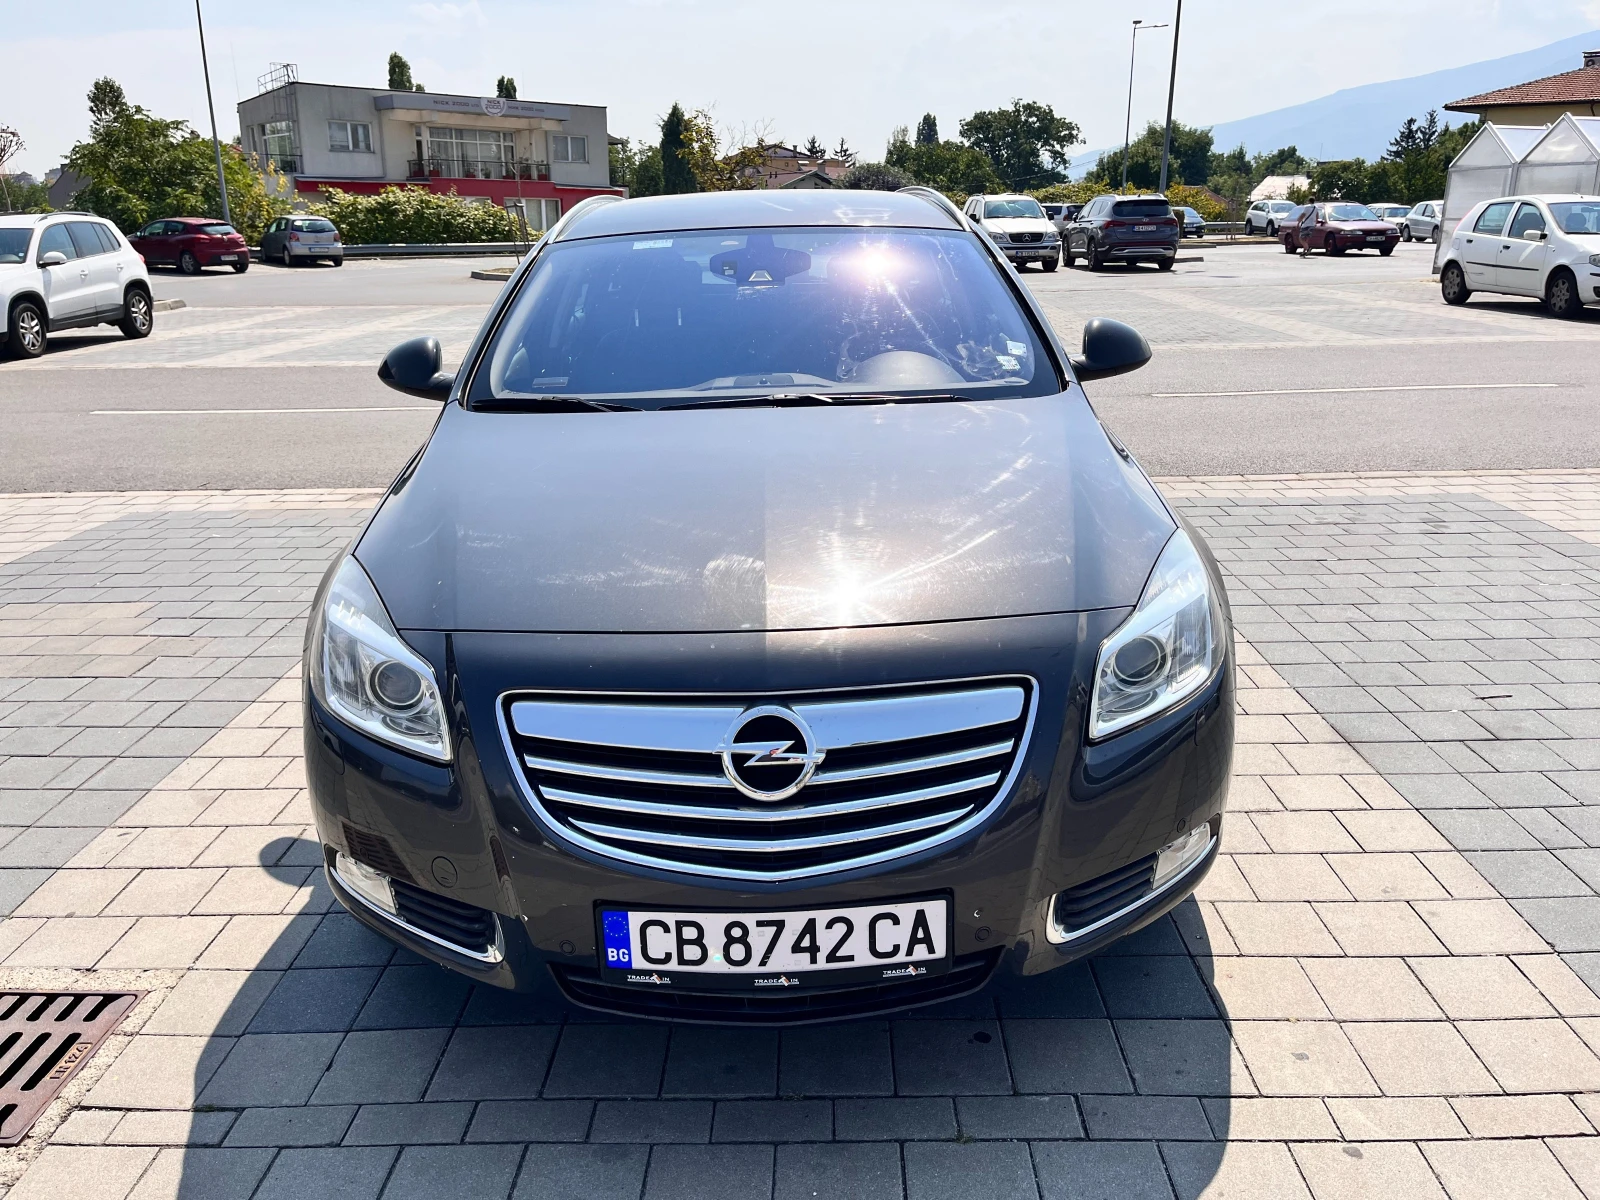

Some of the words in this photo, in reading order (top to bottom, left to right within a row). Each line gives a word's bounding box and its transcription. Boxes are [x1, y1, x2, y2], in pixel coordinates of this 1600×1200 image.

[607, 947, 630, 963] BG
[639, 919, 709, 967] CB
[722, 916, 855, 967] 8742
[868, 908, 937, 960] CA
